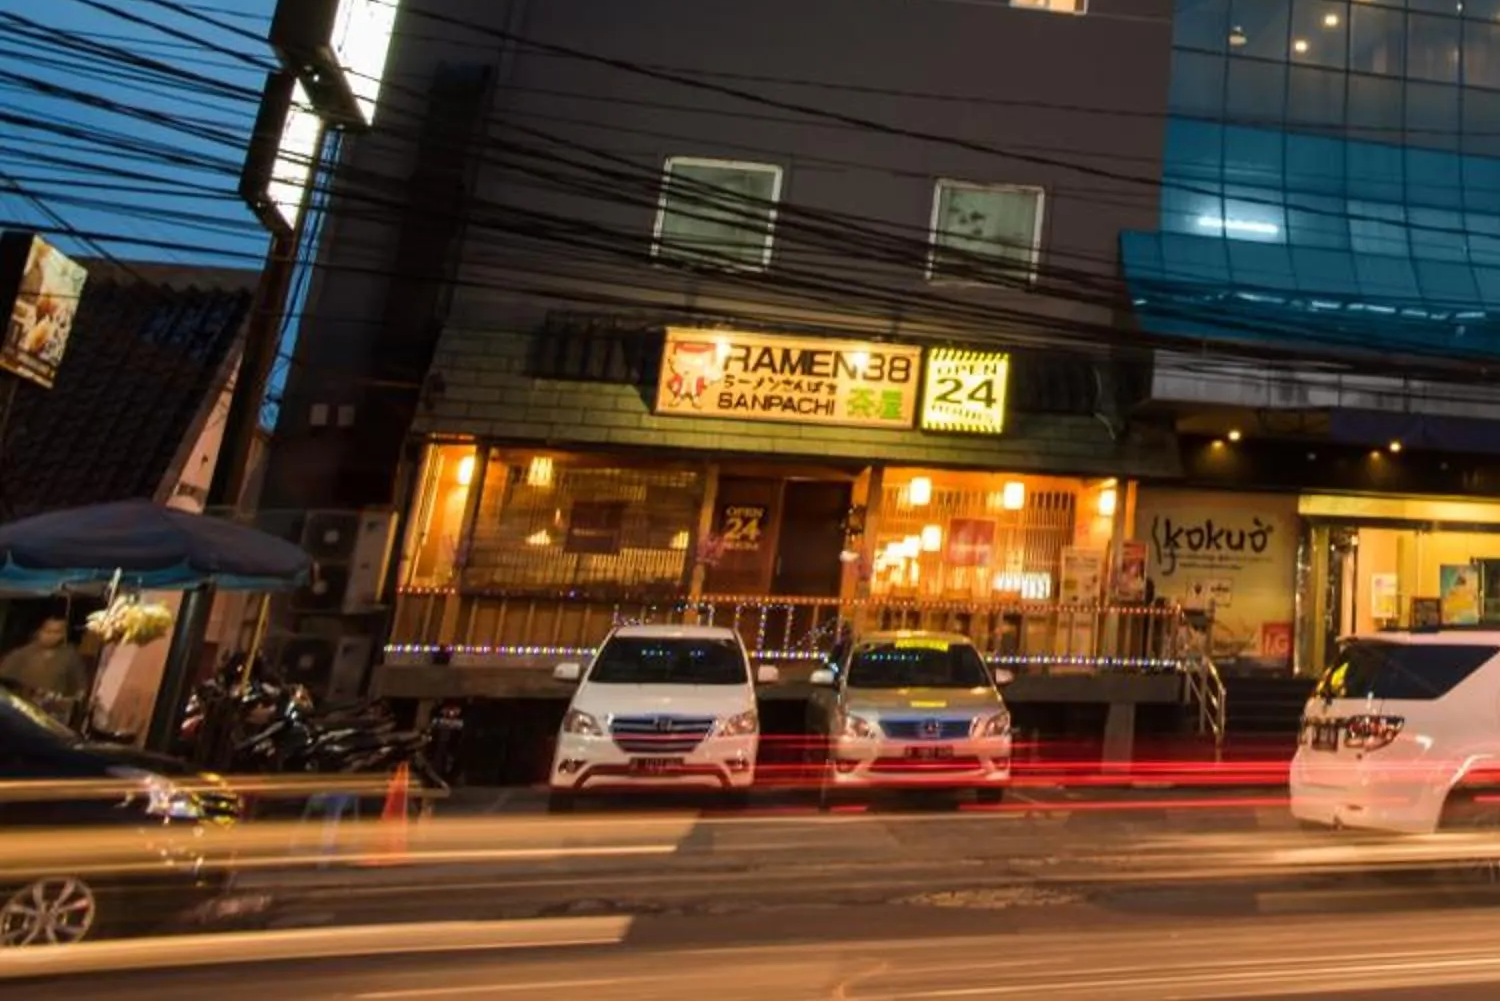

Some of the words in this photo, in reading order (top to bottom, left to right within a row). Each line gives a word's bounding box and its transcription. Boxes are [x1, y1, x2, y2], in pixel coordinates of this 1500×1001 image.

[717, 392, 835, 416] SANPACHI
[934, 378, 997, 409] 24
[723, 518, 761, 540] 24
